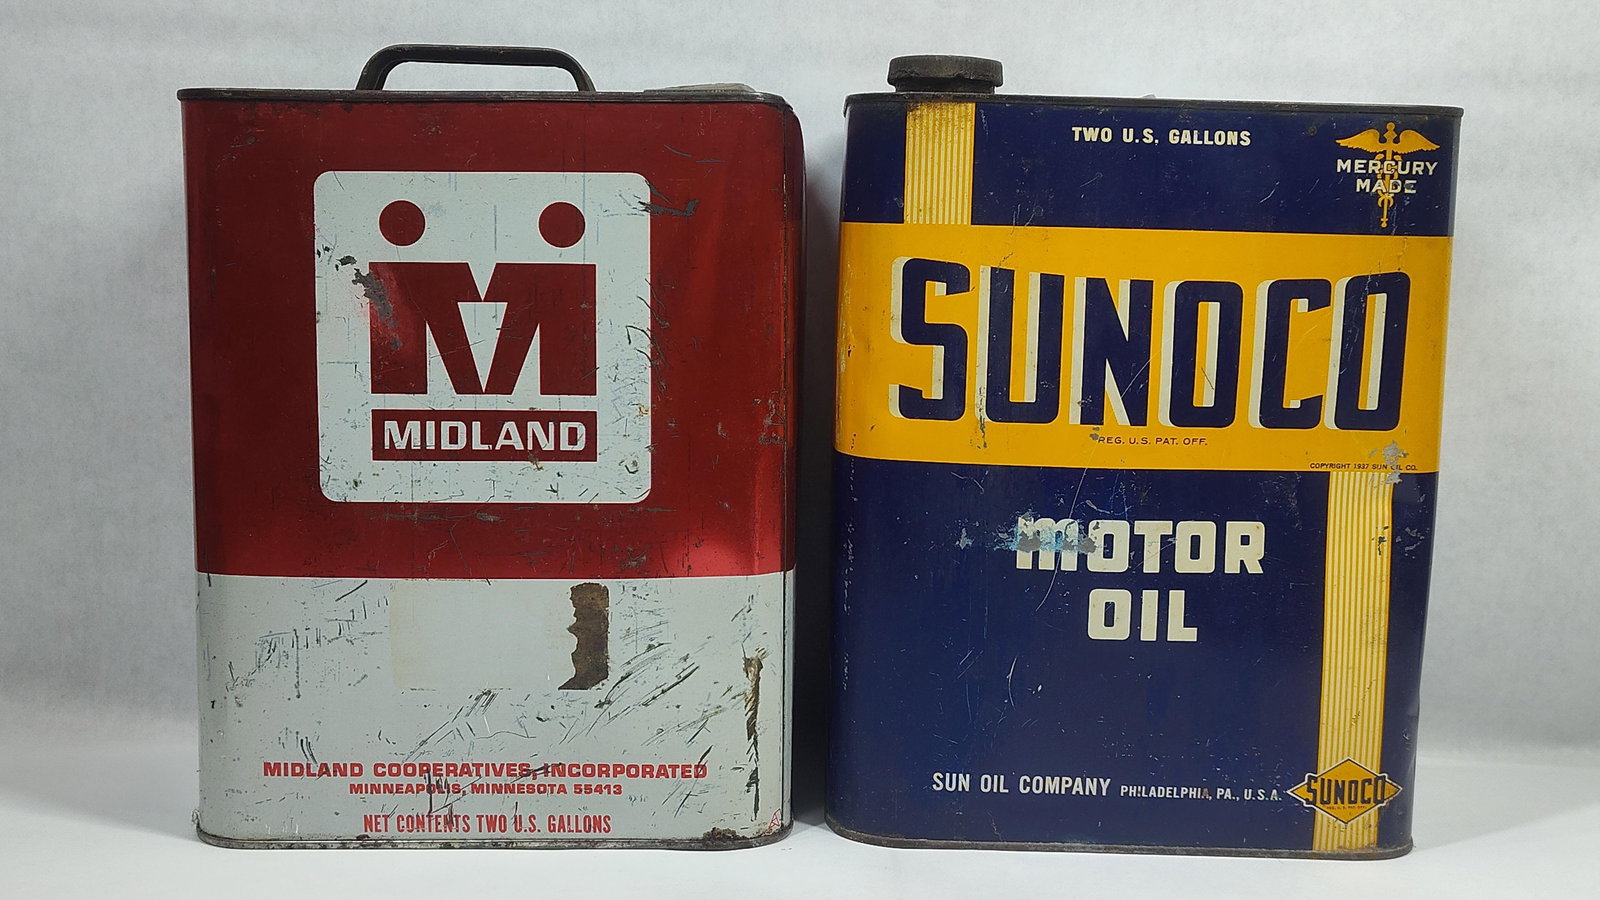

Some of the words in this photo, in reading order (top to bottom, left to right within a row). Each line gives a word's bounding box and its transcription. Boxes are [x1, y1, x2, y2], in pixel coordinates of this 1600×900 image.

[1071, 126, 1112, 142] TWO
[1122, 128, 1159, 144] U.S.
[1168, 129, 1251, 146] GALLONS
[1336, 159, 1438, 175] MERCURY
[1355, 178, 1417, 194] MADE
[888, 256, 1411, 432] SUNOCO
[383, 420, 587, 451] MIDLAND
[1098, 436, 1125, 445] REG.
[1128, 437, 1151, 445] U.S.
[1155, 437, 1179, 445] PAT.
[1183, 437, 1208, 446] OFF.
[1015, 516, 1266, 574] MOTOR
[1087, 588, 1198, 642] OIL
[263, 762, 364, 777] MIDLAND
[373, 762, 537, 780] COOPERATIVES,
[543, 763, 708, 779] INCORPORATED
[349, 783, 467, 796] MINNEAPOLIS,
[471, 783, 568, 795] MINNESOTA
[573, 784, 623, 795] 55413
[932, 772, 970, 792] SUN
[980, 774, 1009, 793] OIL
[1019, 775, 1111, 796] COMPANY
[1120, 785, 1212, 800] PHILADELPHIA,
[1216, 787, 1240, 801] PA.,
[1243, 789, 1282, 801] U.S.A.
[1304, 774, 1386, 805] SUNOCO
[363, 814, 389, 833] NET
[396, 814, 471, 833] CONTENTS
[476, 814, 507, 833] TWO
[513, 814, 541, 833] U.S.
[547, 814, 611, 833] GALLONS
